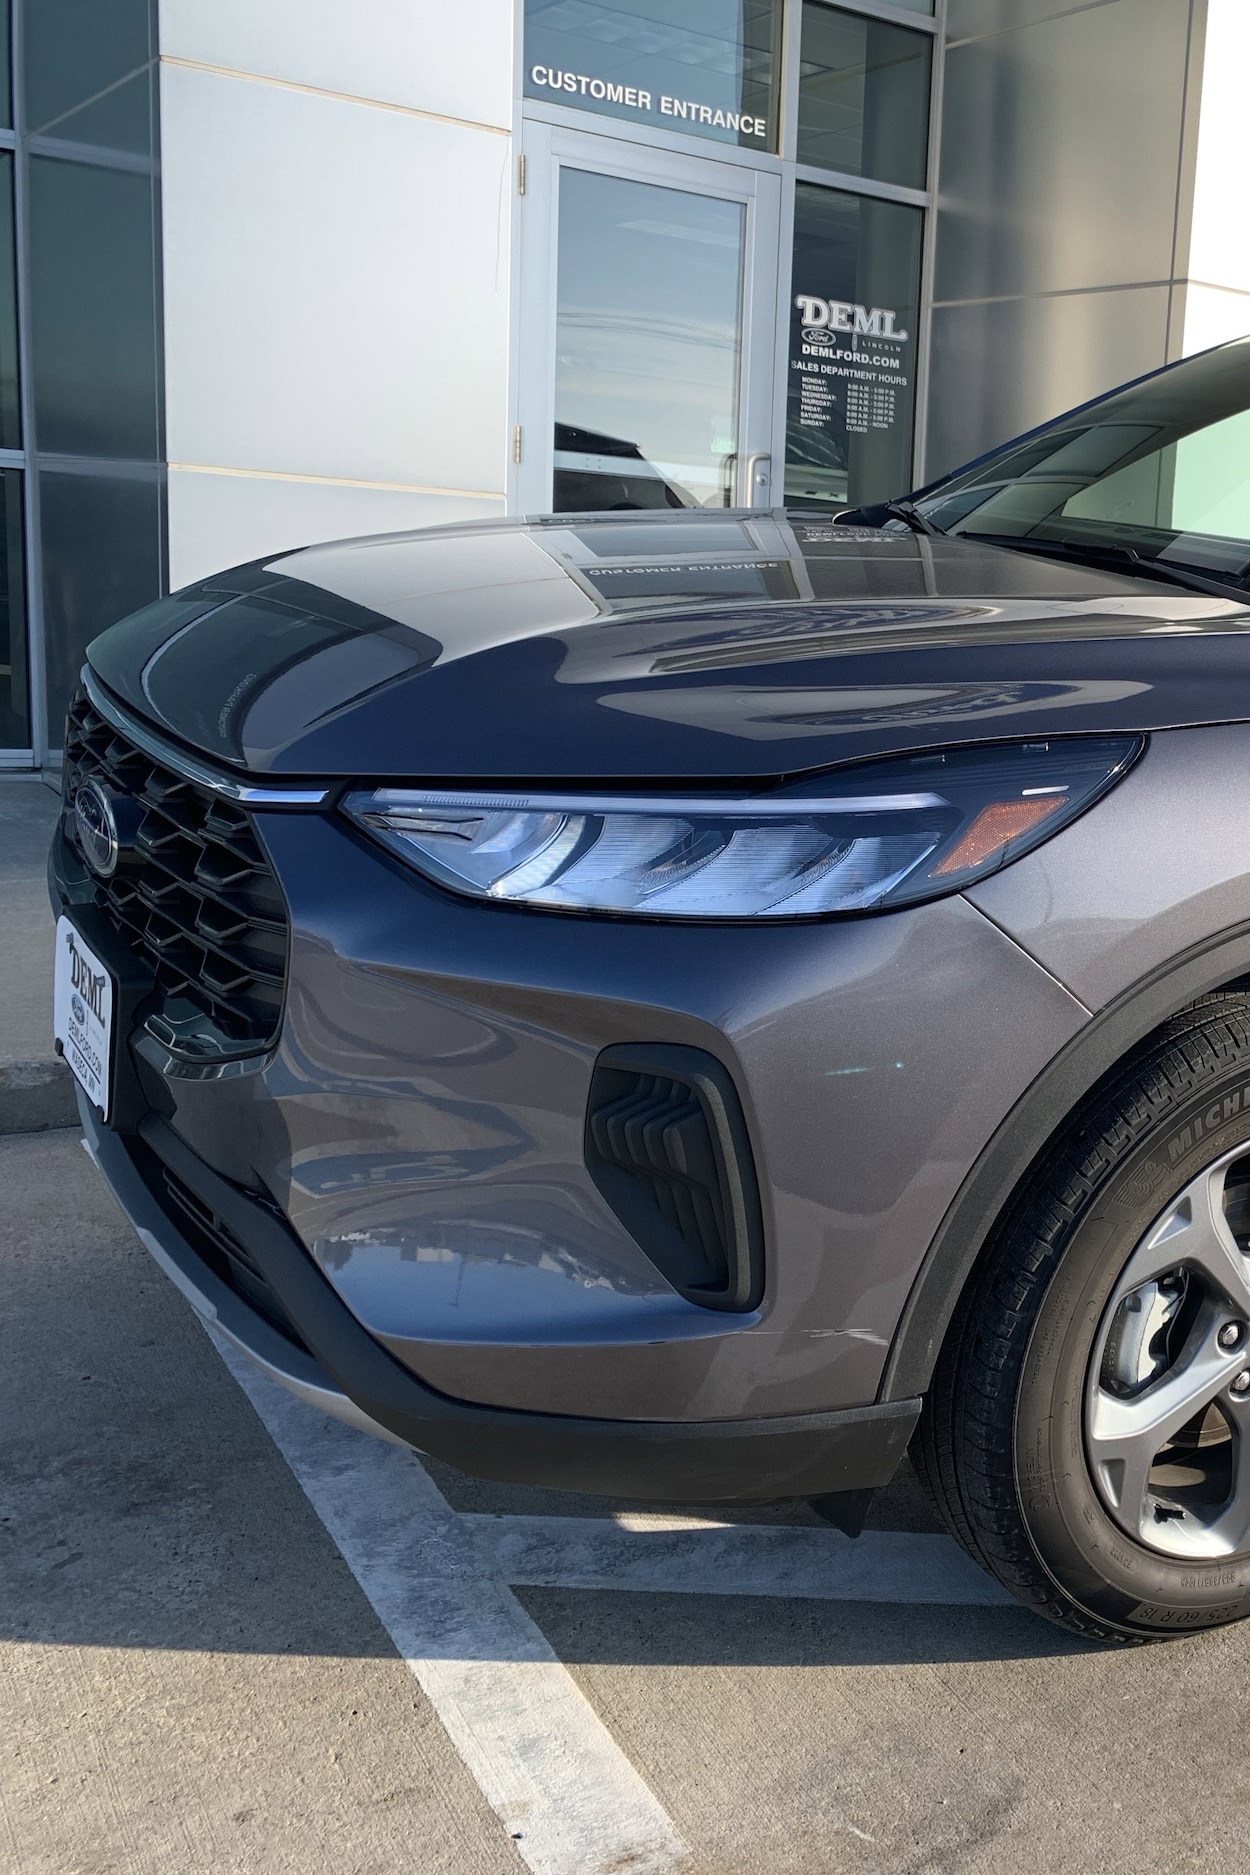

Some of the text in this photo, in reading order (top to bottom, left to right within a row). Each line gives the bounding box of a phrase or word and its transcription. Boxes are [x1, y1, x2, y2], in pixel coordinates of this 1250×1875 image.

[531, 65, 766, 137] CUSTOMER ENTRANCE
[795, 295, 908, 342] DEML
[802, 344, 900, 369] DEMLFORD.COM
[862, 340, 901, 352] LINCOLN
[791, 360, 907, 386] SALES DEPARTMENT HOURS
[846, 425, 868, 433] CLOSED
[69, 943, 106, 1030] DEML
[1140, 1604, 1240, 1624] 225/60 R 18
